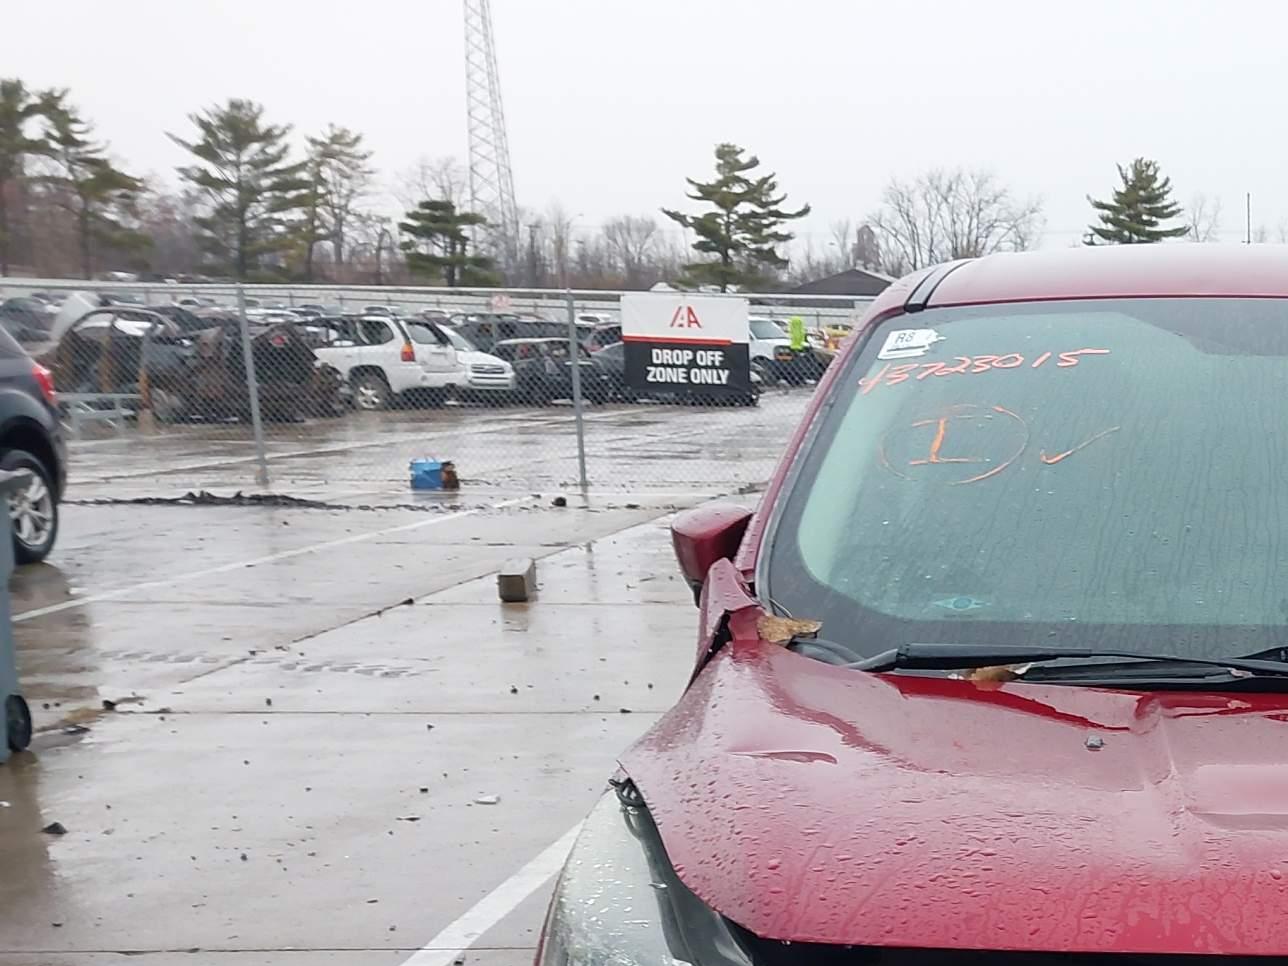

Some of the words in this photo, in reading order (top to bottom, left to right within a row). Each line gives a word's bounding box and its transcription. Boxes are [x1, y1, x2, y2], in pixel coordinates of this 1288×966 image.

[651, 348, 693, 365] DROP
[696, 350, 725, 367] OFF
[645, 366, 687, 383] ZONE
[689, 368, 730, 385] ONLY
[857, 348, 1111, 395] 43723015
